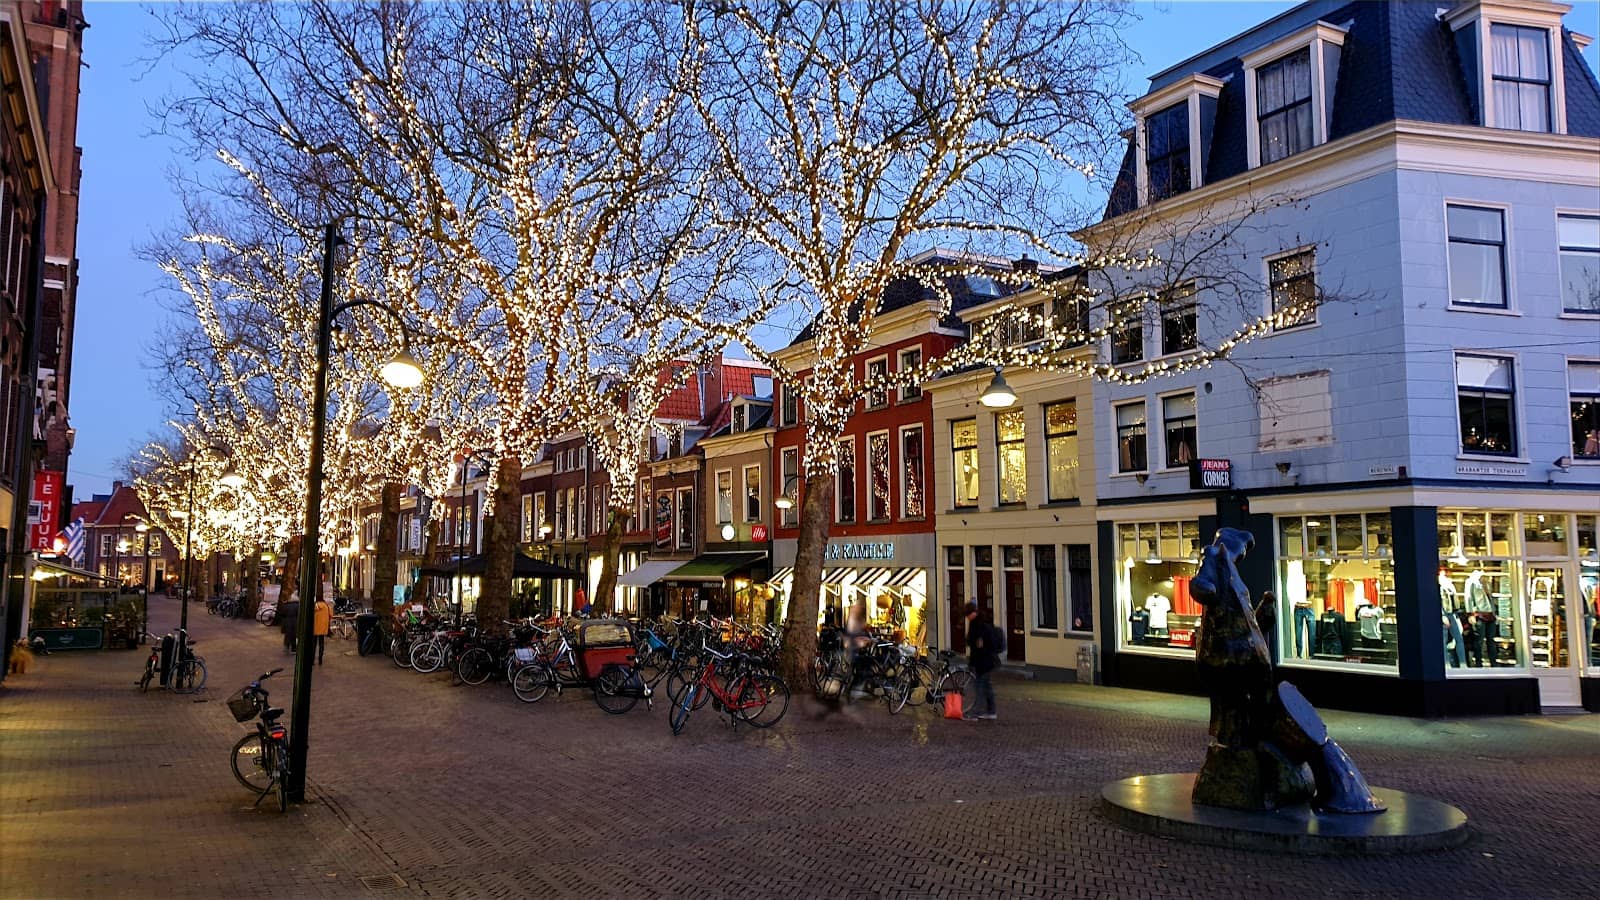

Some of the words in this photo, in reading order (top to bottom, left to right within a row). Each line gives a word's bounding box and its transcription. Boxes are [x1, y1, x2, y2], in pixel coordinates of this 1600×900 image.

[1203, 460, 1229, 469] JEANS
[1203, 471, 1230, 486] CORNER
[38, 500, 52, 547] HUUR
[752, 527, 766, 540] illy
